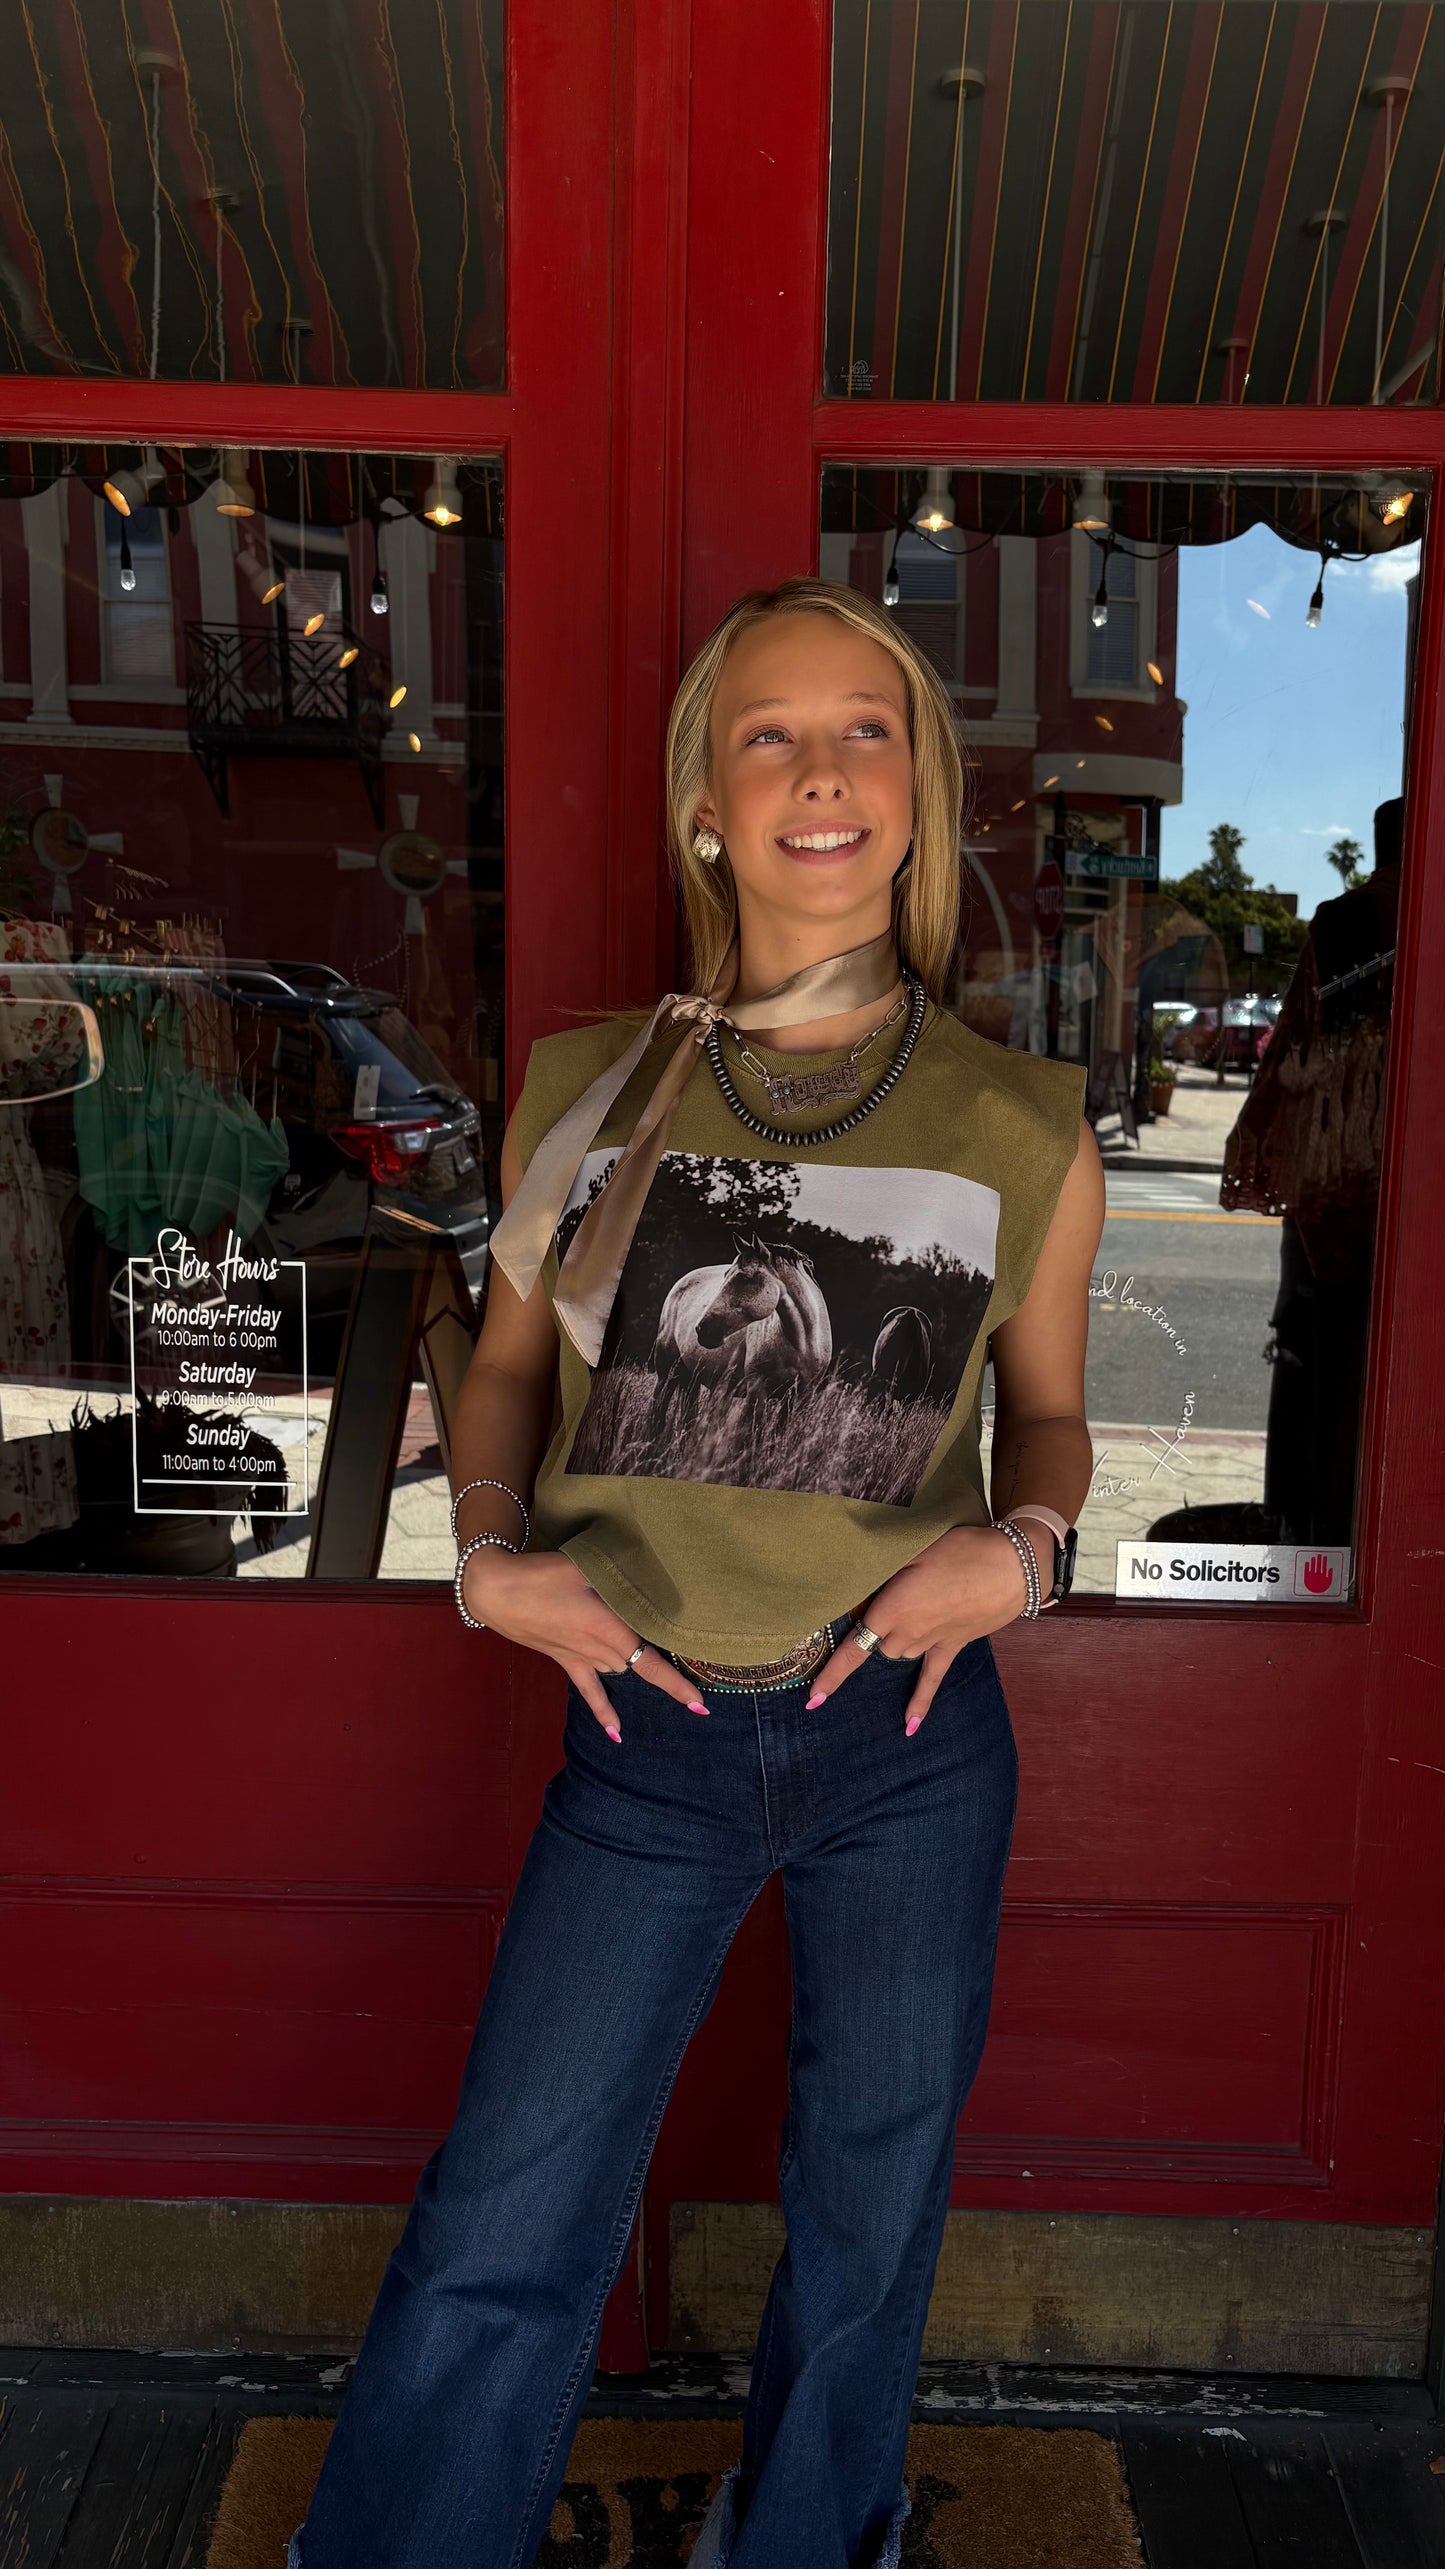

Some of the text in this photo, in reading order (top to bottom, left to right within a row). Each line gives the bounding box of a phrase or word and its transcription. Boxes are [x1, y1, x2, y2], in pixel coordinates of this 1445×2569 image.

[152, 1227, 281, 1290] Store Hours
[151, 1302, 282, 1331] Monday-Friday
[1088, 1270, 1187, 1356] nd location in
[157, 1330, 210, 1347] 10:00am
[213, 1332, 225, 1347] to
[178, 1361, 256, 1388] Saturday
[162, 1390, 209, 1406] 9:00am
[212, 1391, 225, 1406] to
[186, 1423, 251, 1450] Sunday
[1139, 1390, 1196, 1481] Haven
[162, 1454, 210, 1471] 11:00am
[213, 1455, 225, 1472] to
[1131, 1558, 1281, 1583] No Solicitors
